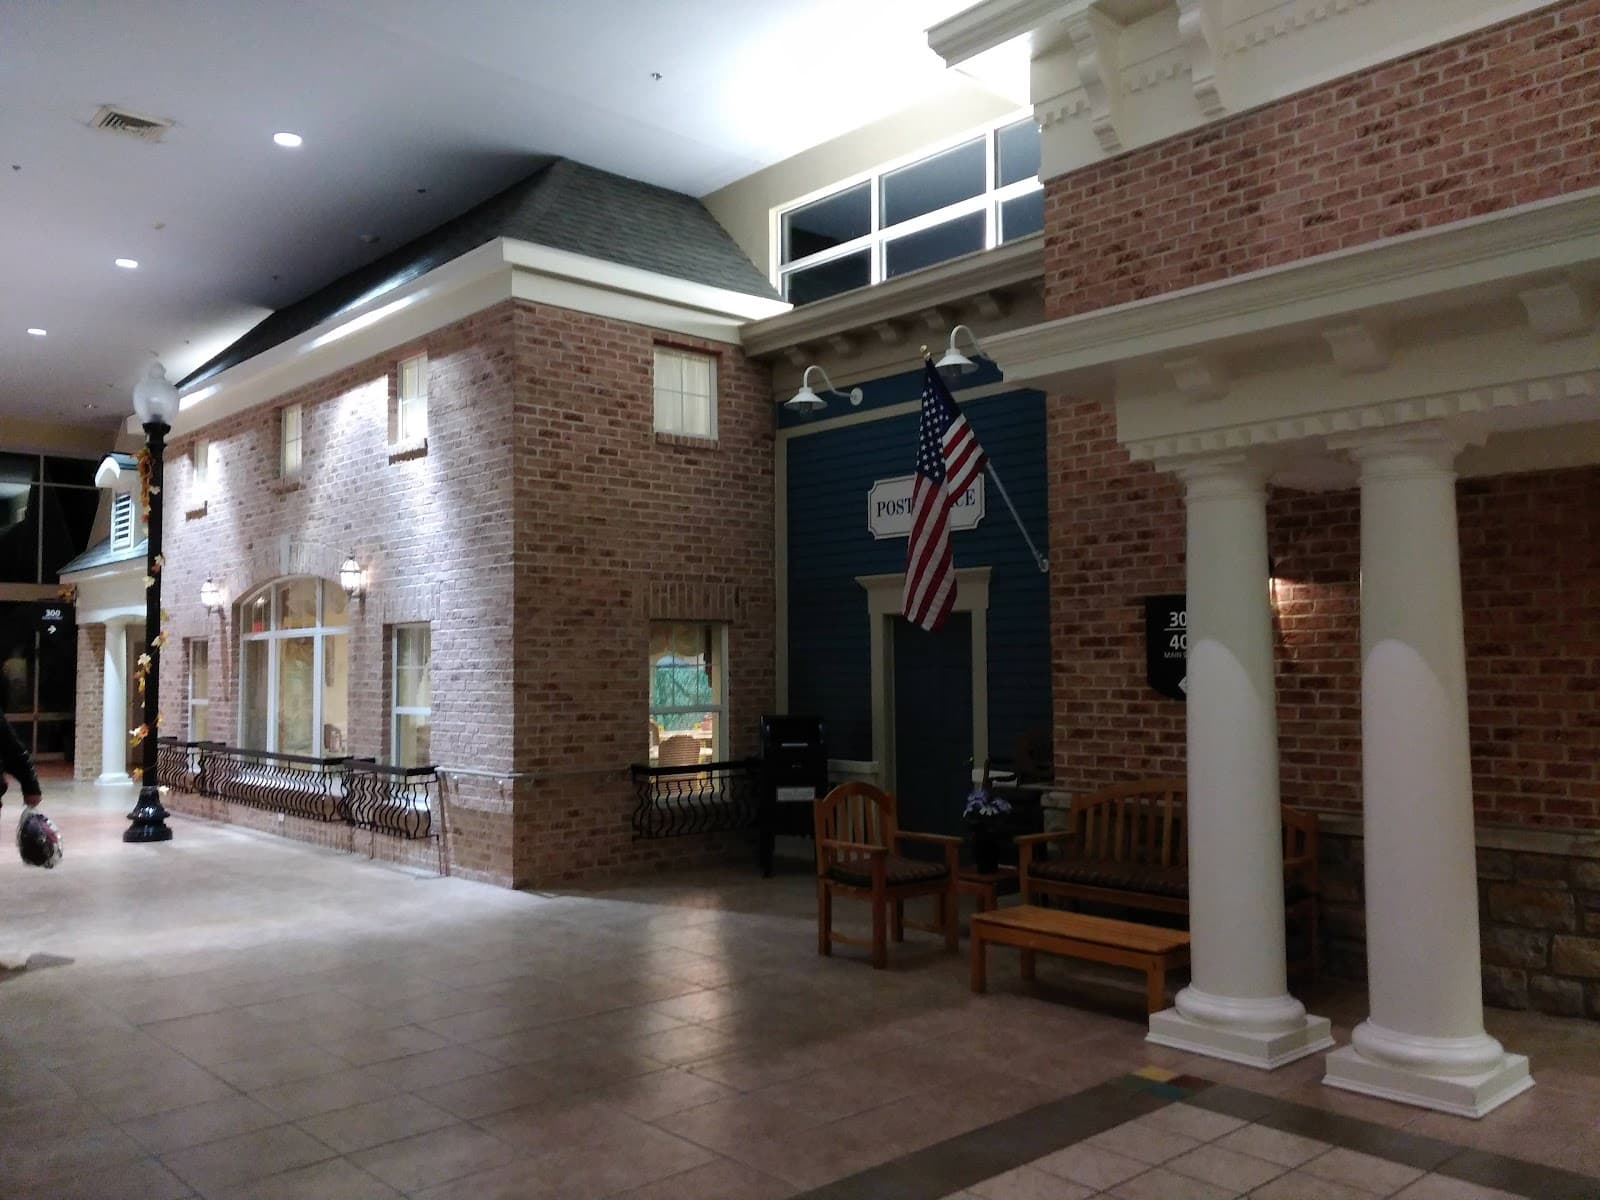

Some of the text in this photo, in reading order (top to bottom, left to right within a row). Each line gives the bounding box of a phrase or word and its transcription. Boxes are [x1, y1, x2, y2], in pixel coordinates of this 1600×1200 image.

[877, 497, 912, 517] POST
[1169, 611, 1187, 627] 30
[1169, 634, 1187, 650] 40
